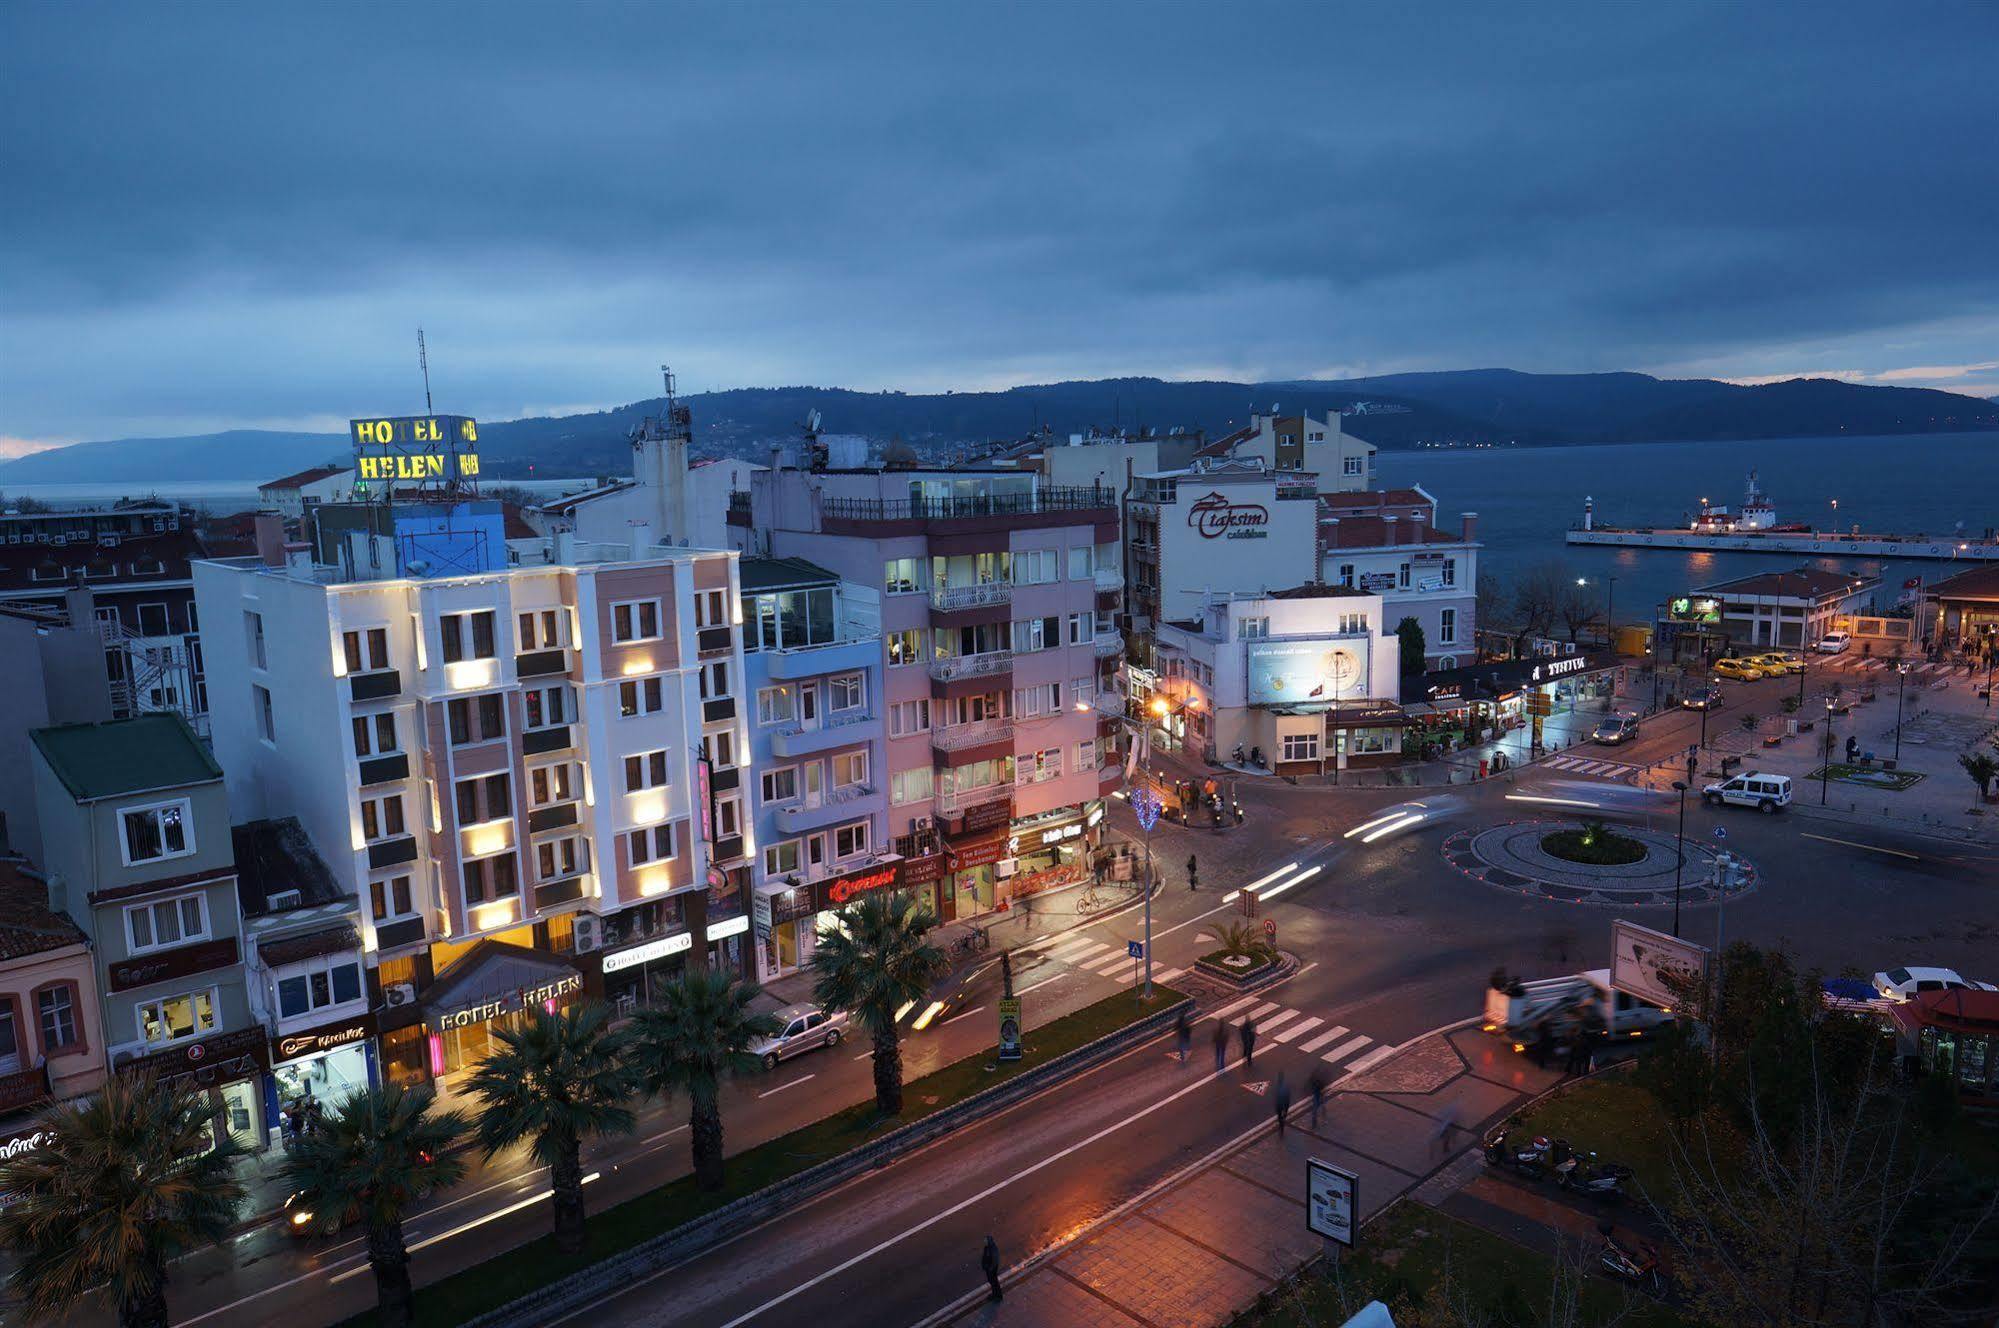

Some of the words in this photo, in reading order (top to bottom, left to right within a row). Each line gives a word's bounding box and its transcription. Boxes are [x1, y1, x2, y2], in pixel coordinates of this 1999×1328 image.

[357, 420, 443, 444] HOTEL
[359, 455, 445, 479] HELEN
[440, 1001, 507, 1031] HOTEL
[523, 975, 581, 1007] HELEN
